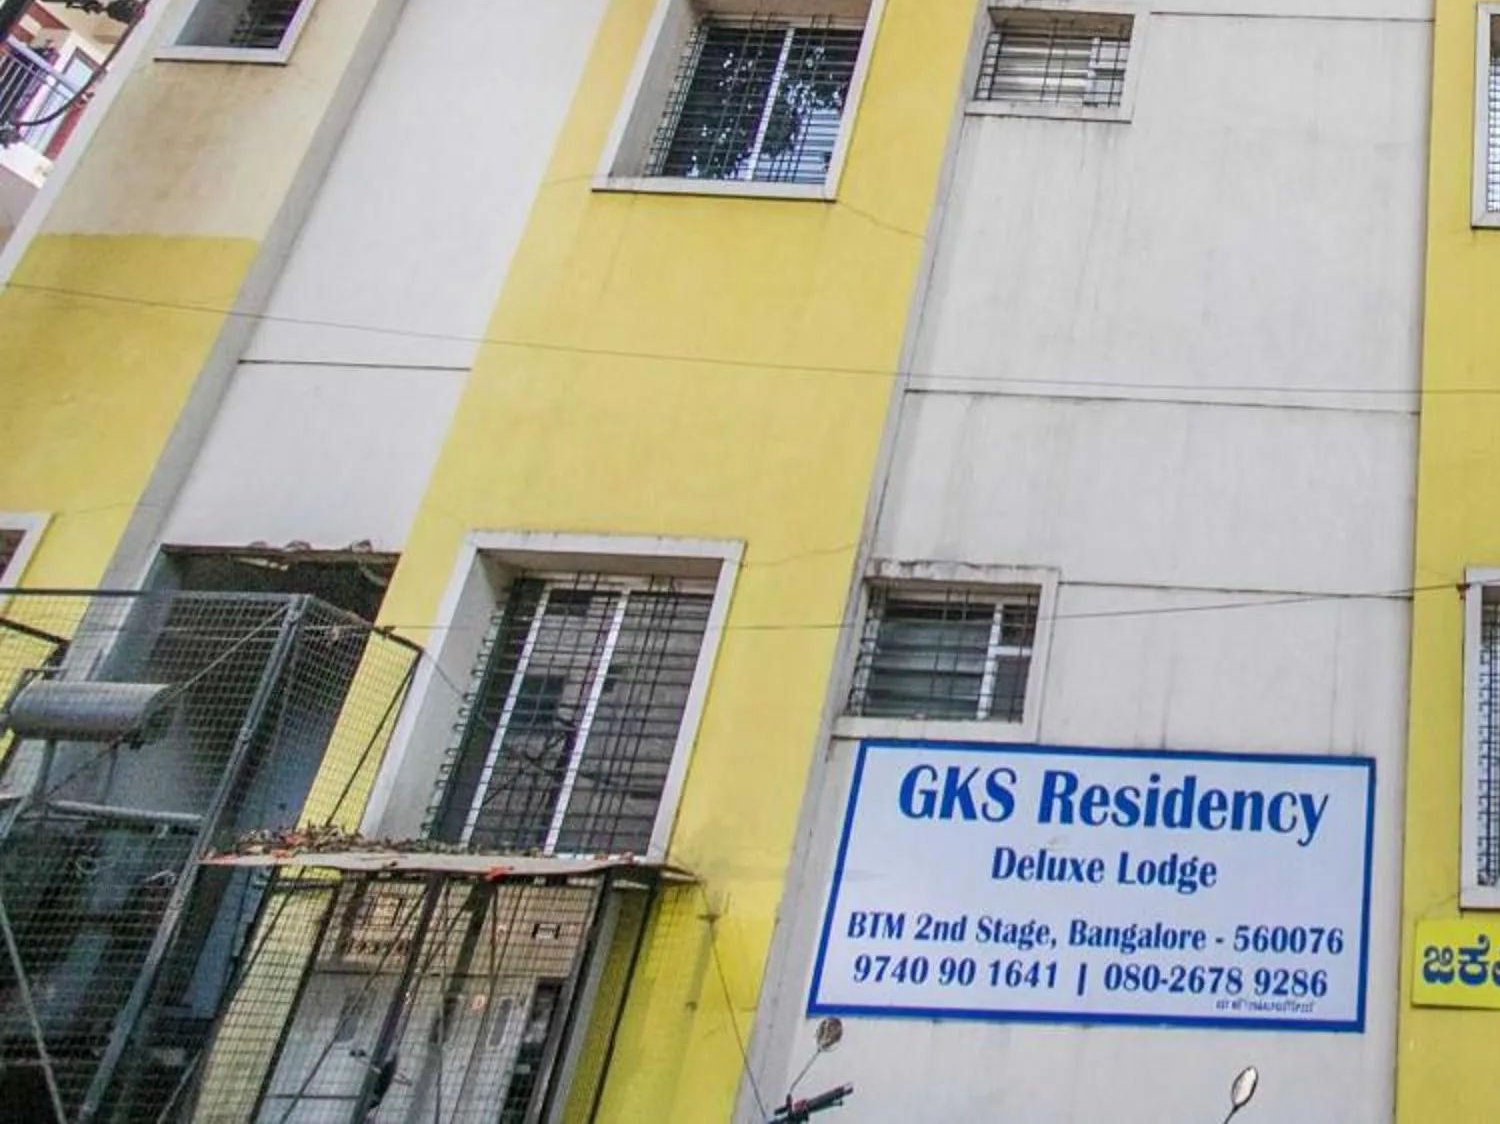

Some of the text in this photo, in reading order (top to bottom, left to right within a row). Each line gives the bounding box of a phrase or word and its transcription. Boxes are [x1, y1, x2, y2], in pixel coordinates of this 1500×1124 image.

[898, 763, 1329, 847] GKS Residency
[991, 846, 1217, 895] Deluxe Lodge
[847, 911, 906, 941] BTM
[914, 913, 968, 942] 2nd
[975, 917, 1057, 951] Stage,
[1068, 919, 1207, 955] Bangalore
[1233, 924, 1344, 955] 560076
[853, 955, 929, 985] 9740
[938, 957, 977, 987] 90
[989, 959, 1057, 989] 1641
[1103, 963, 1244, 996] 080-2678
[1253, 967, 1328, 998] 9286
